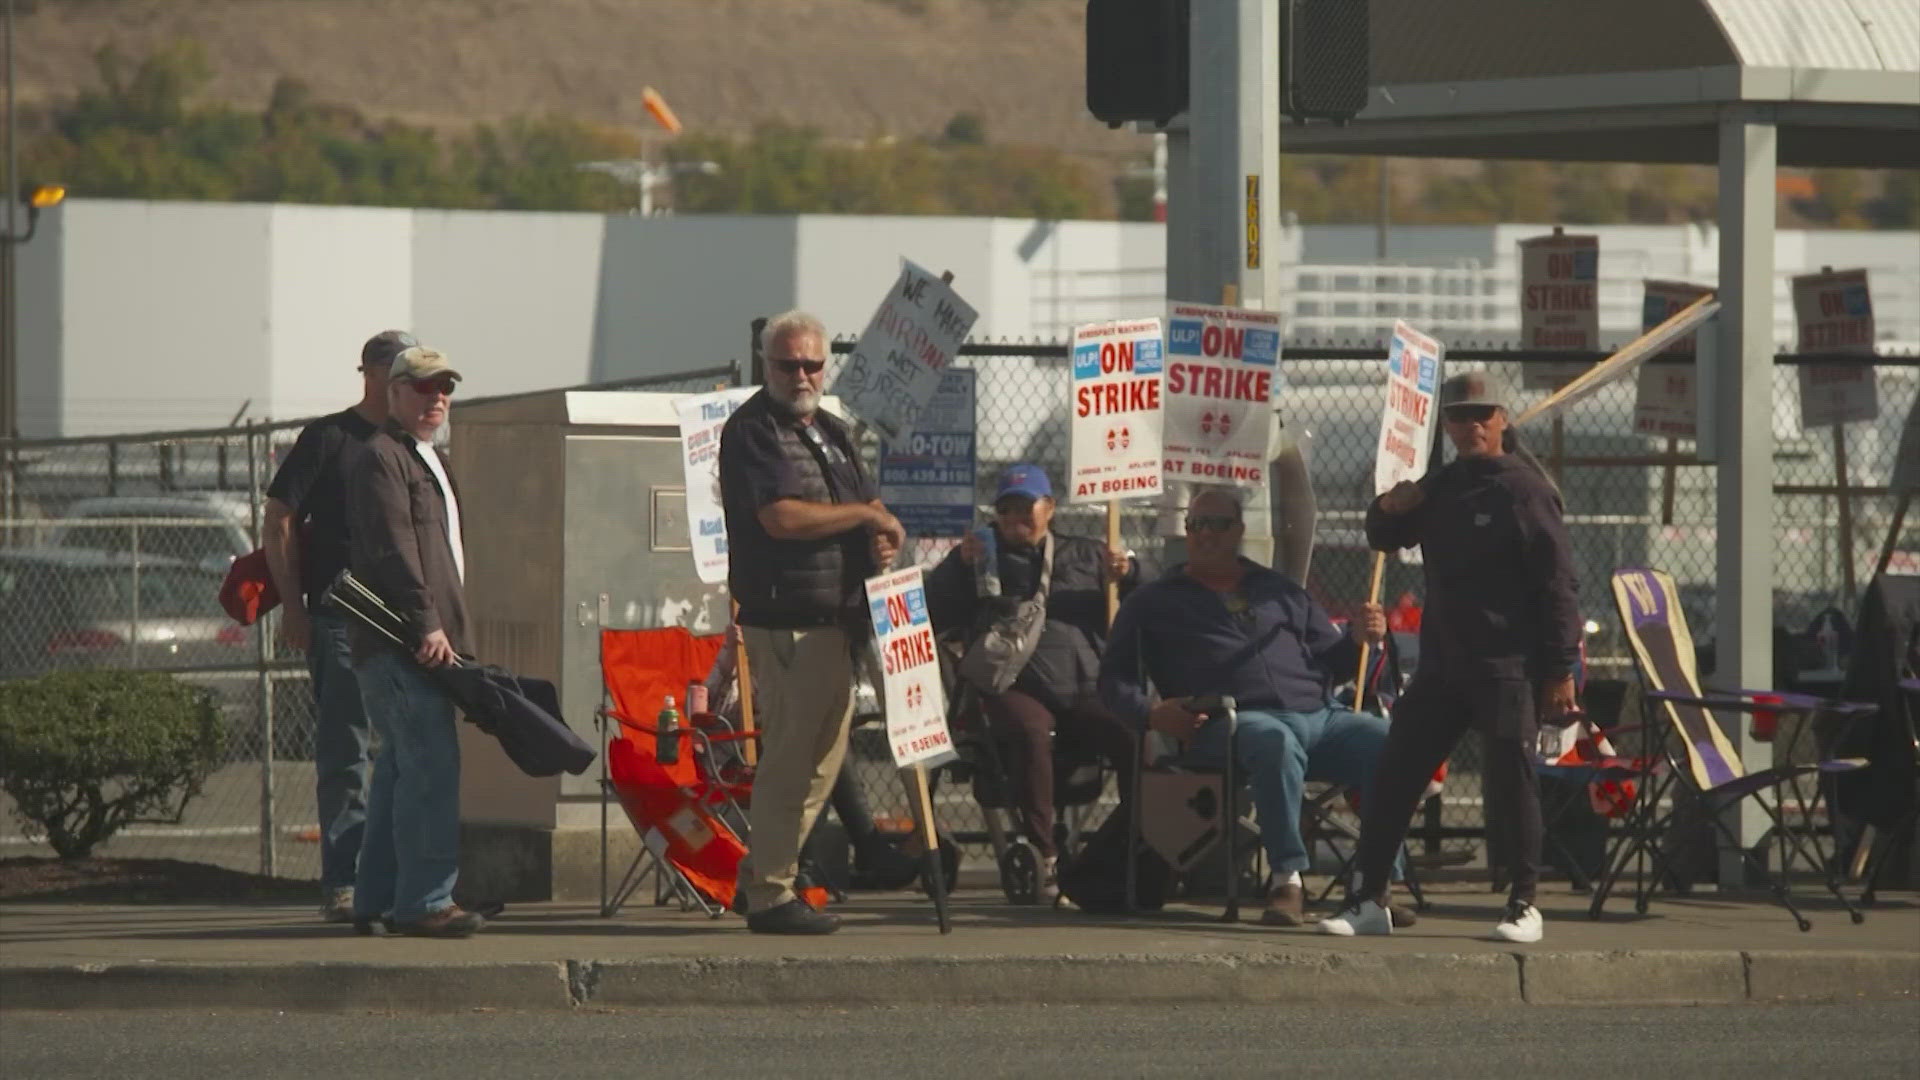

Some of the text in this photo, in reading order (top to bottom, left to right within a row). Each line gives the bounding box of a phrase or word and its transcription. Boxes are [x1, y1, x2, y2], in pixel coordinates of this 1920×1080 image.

[1247, 175, 1258, 268] 7602
[1548, 253, 1573, 280] ON
[902, 270, 929, 308] WE
[1527, 285, 1593, 310] STRIKE
[1820, 290, 1843, 317] ON
[1203, 326, 1245, 360] ON
[1805, 319, 1870, 349] STRIKE
[887, 349, 922, 381] NOT
[1101, 341, 1134, 374] ON
[1402, 349, 1419, 384] ON
[1078, 379, 1159, 418] STRIKE
[1168, 362, 1271, 402] STRIKE
[1390, 379, 1428, 426] STRIKE
[1077, 475, 1158, 496] AT BOEING
[1163, 459, 1261, 481] AT BOEING
[886, 593, 910, 628] ON
[884, 630, 934, 676] STRIKE
